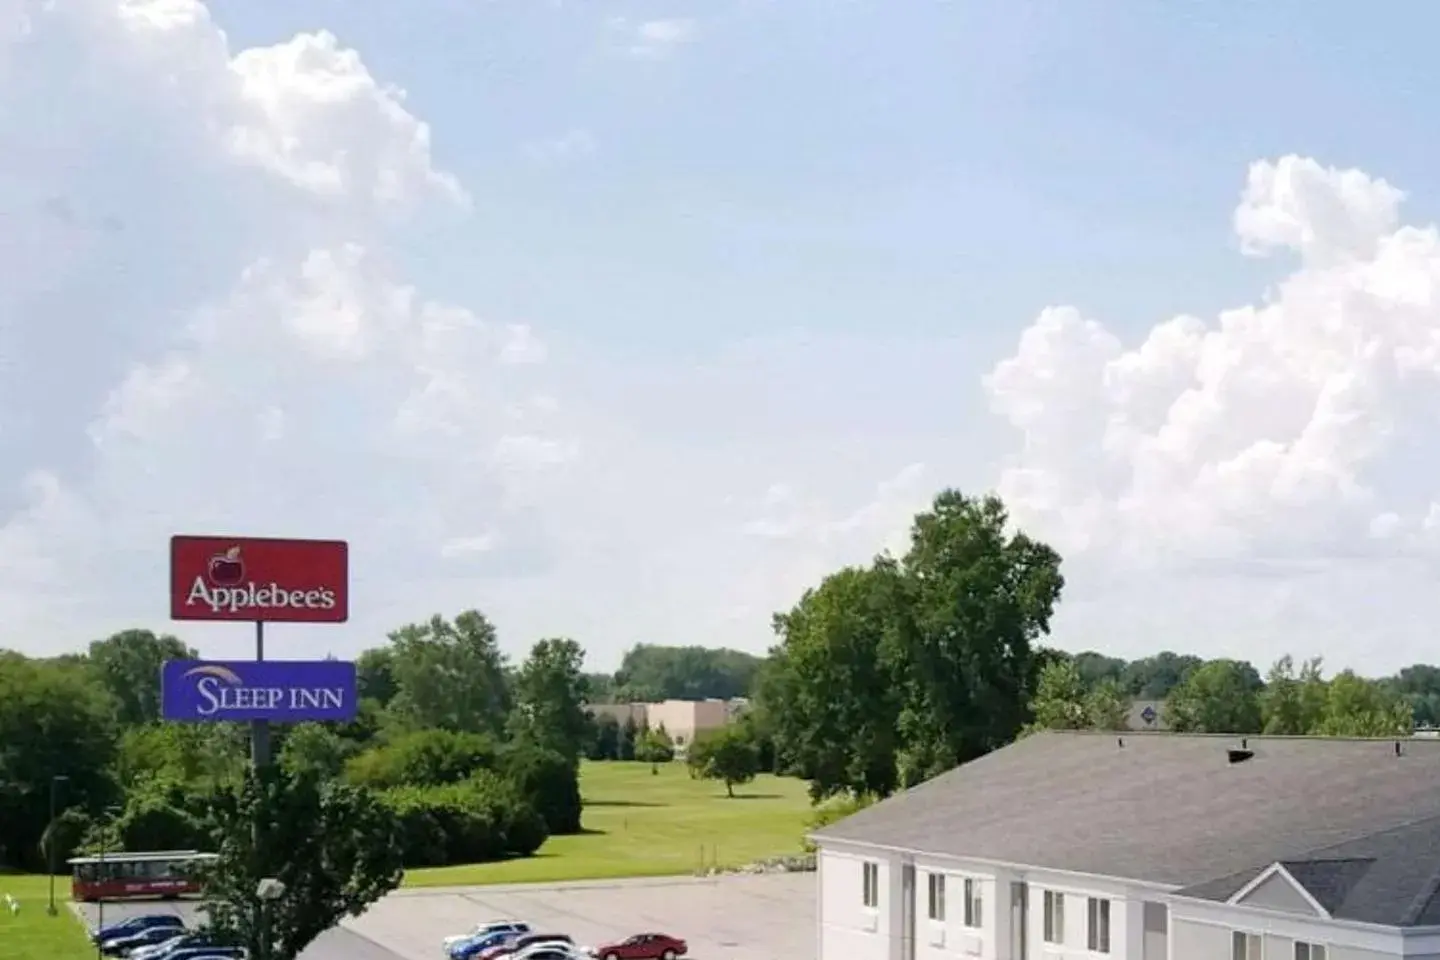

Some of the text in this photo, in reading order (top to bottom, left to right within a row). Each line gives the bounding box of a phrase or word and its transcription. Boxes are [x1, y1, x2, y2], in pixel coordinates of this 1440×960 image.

[186, 576, 336, 613] Applebee's
[196, 676, 344, 715] SLEEP INN
